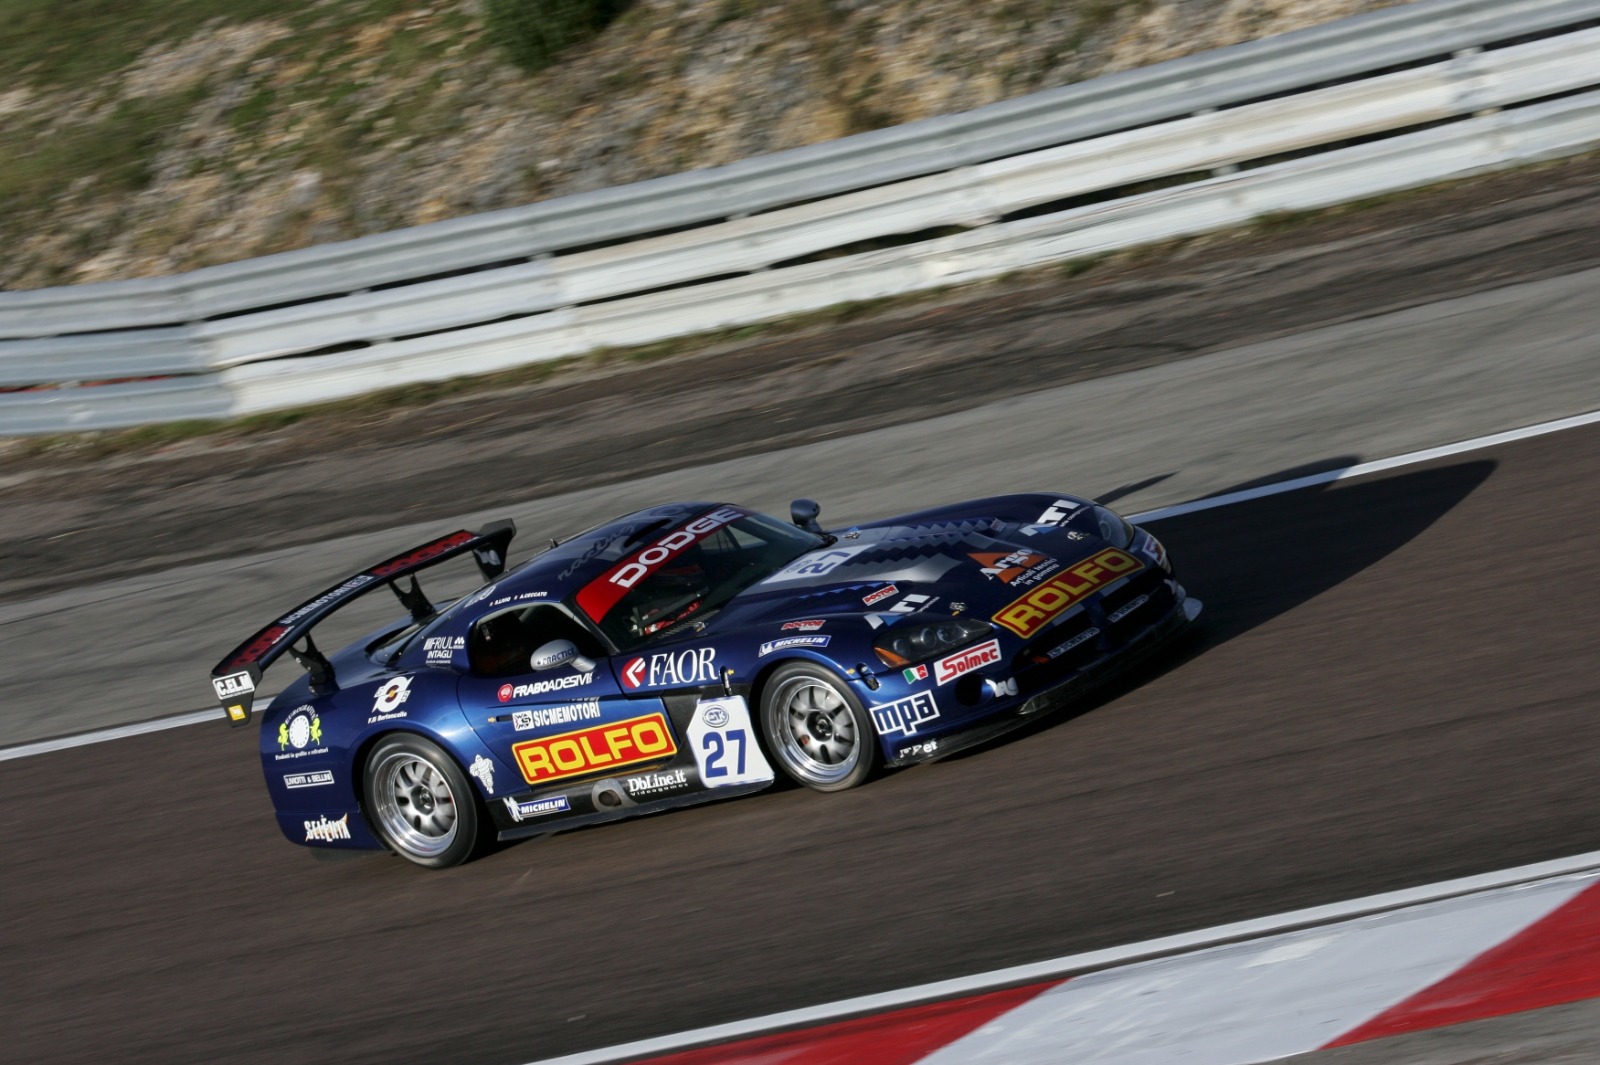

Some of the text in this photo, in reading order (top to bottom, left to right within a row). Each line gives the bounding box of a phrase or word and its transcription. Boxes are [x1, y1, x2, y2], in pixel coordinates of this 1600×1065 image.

[608, 508, 745, 588] DODGE
[979, 549, 1033, 581] Argo
[863, 585, 896, 604] DOCTOR
[999, 550, 1136, 632] ROLFO
[1010, 566, 1036, 587] Articoli
[774, 637, 826, 648] MICHELIN
[648, 647, 719, 687] FAOR
[939, 641, 999, 682] Solmec
[533, 699, 601, 727] SICMEMOTORI
[871, 691, 938, 735] mpa
[518, 721, 668, 778] ROLFO
[702, 728, 747, 779] 27
[627, 769, 688, 793] DbLine.it
[520, 799, 566, 815] MICHELIN
